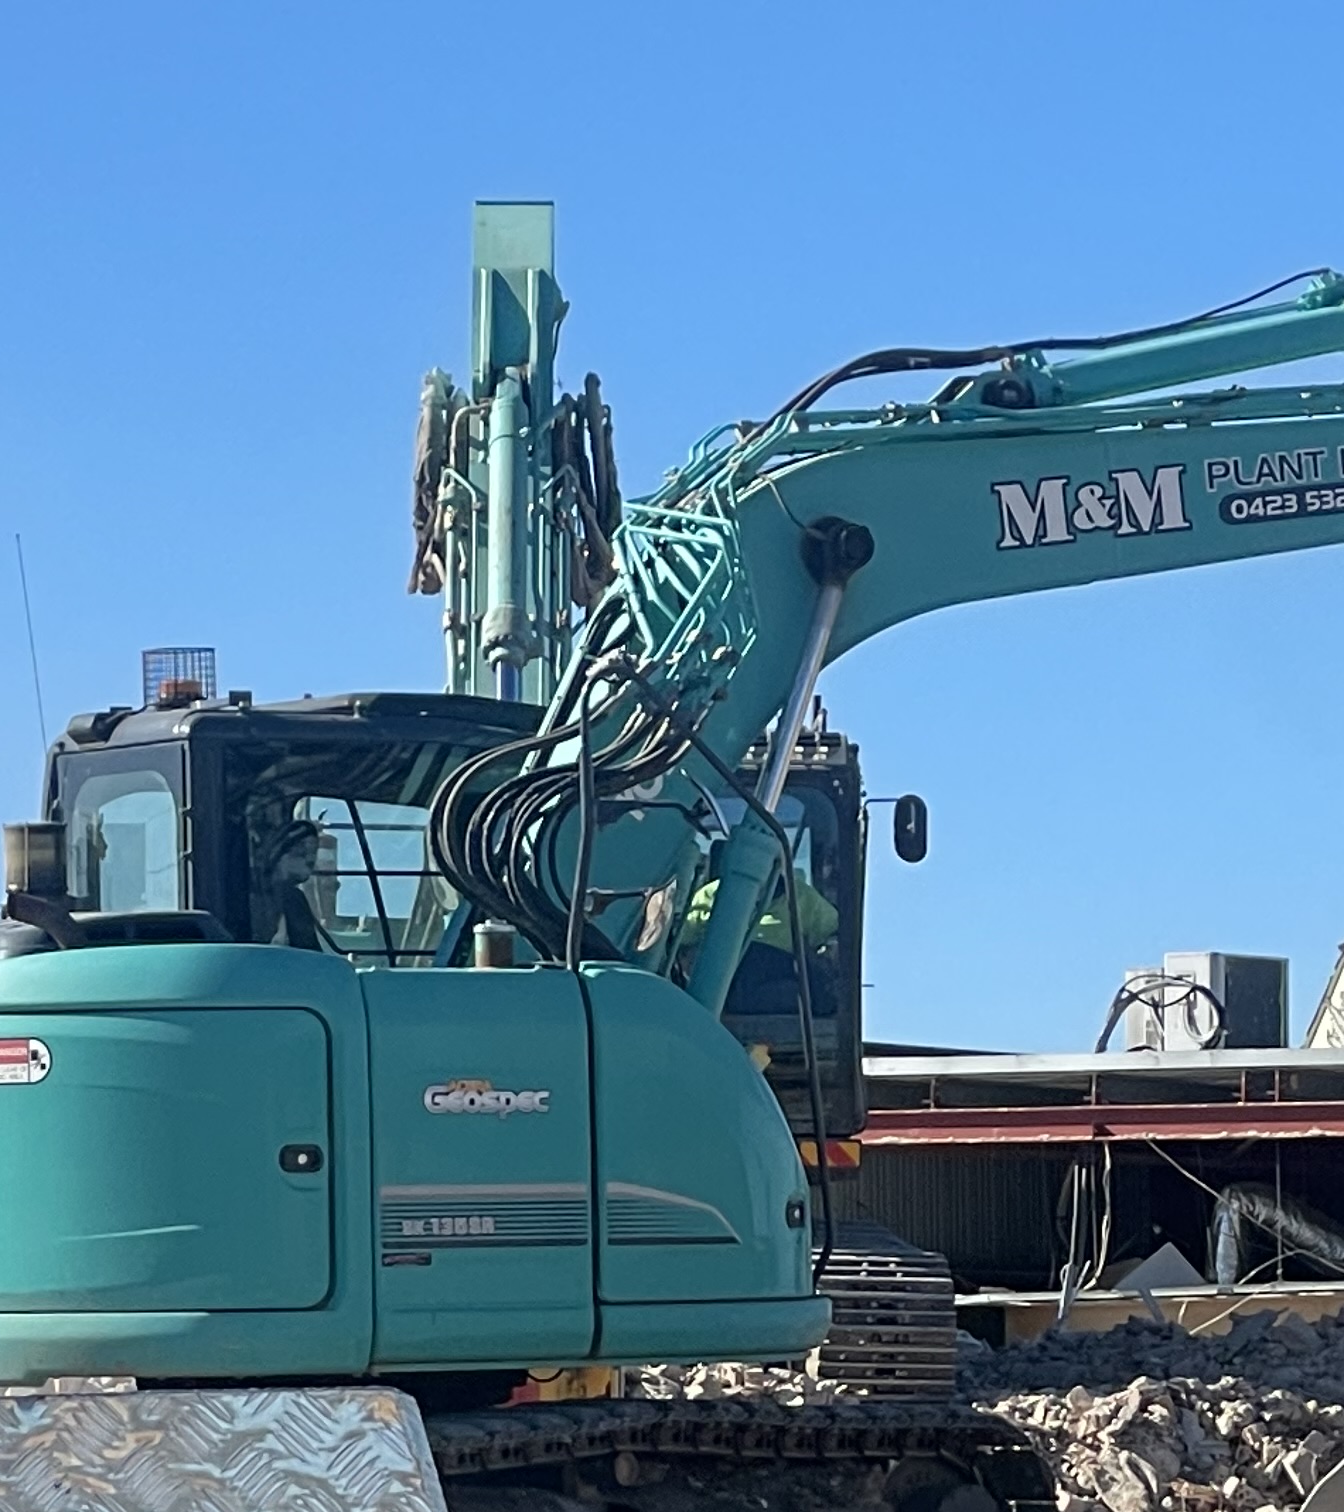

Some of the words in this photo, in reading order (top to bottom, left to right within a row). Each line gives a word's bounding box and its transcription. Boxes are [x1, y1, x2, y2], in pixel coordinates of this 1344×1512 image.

[1204, 446, 1327, 493] PLANT
[993, 463, 1192, 550] M&M
[1231, 494, 1298, 519] 0423
[424, 1085, 550, 1119] Geospec
